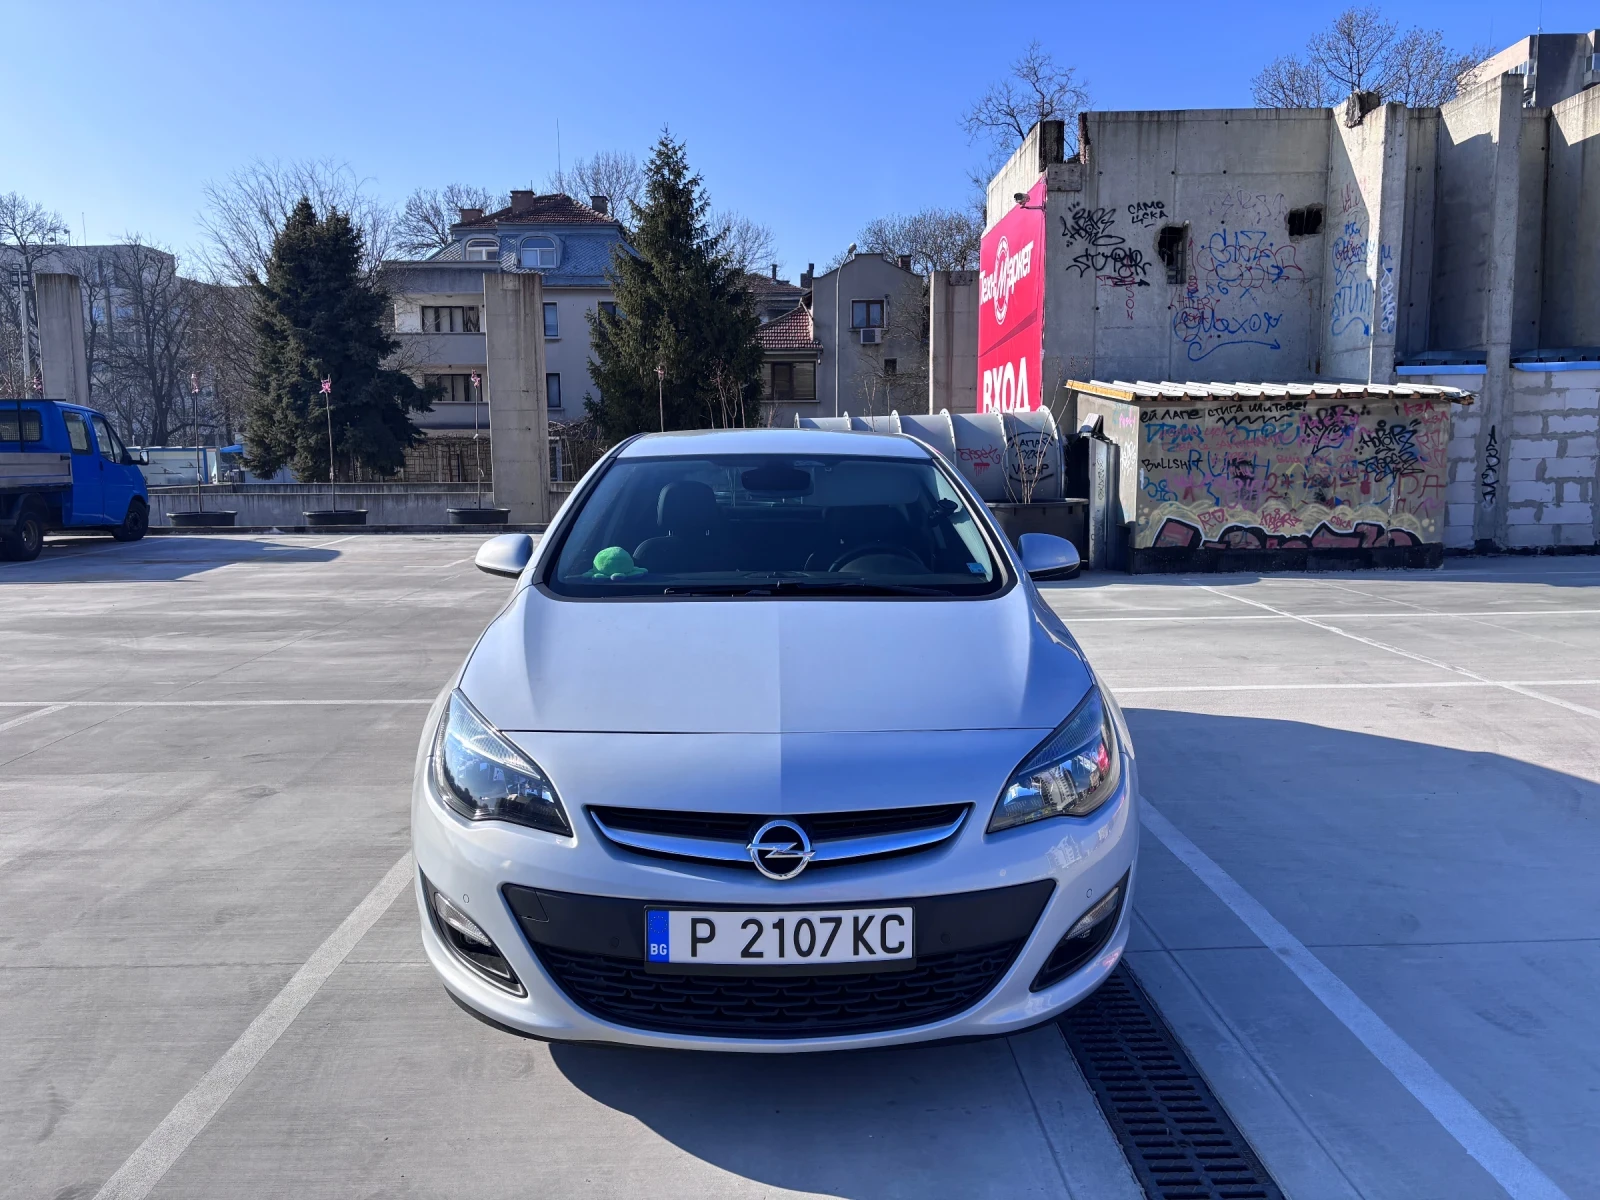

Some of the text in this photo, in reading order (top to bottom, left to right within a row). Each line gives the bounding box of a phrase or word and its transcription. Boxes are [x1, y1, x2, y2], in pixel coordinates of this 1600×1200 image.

[1128, 201, 1165, 214] САМО
[1131, 210, 1168, 224] ЦСКА
[982, 357, 1031, 413] ВХОД
[650, 914, 905, 958] BG P 2107 KC
